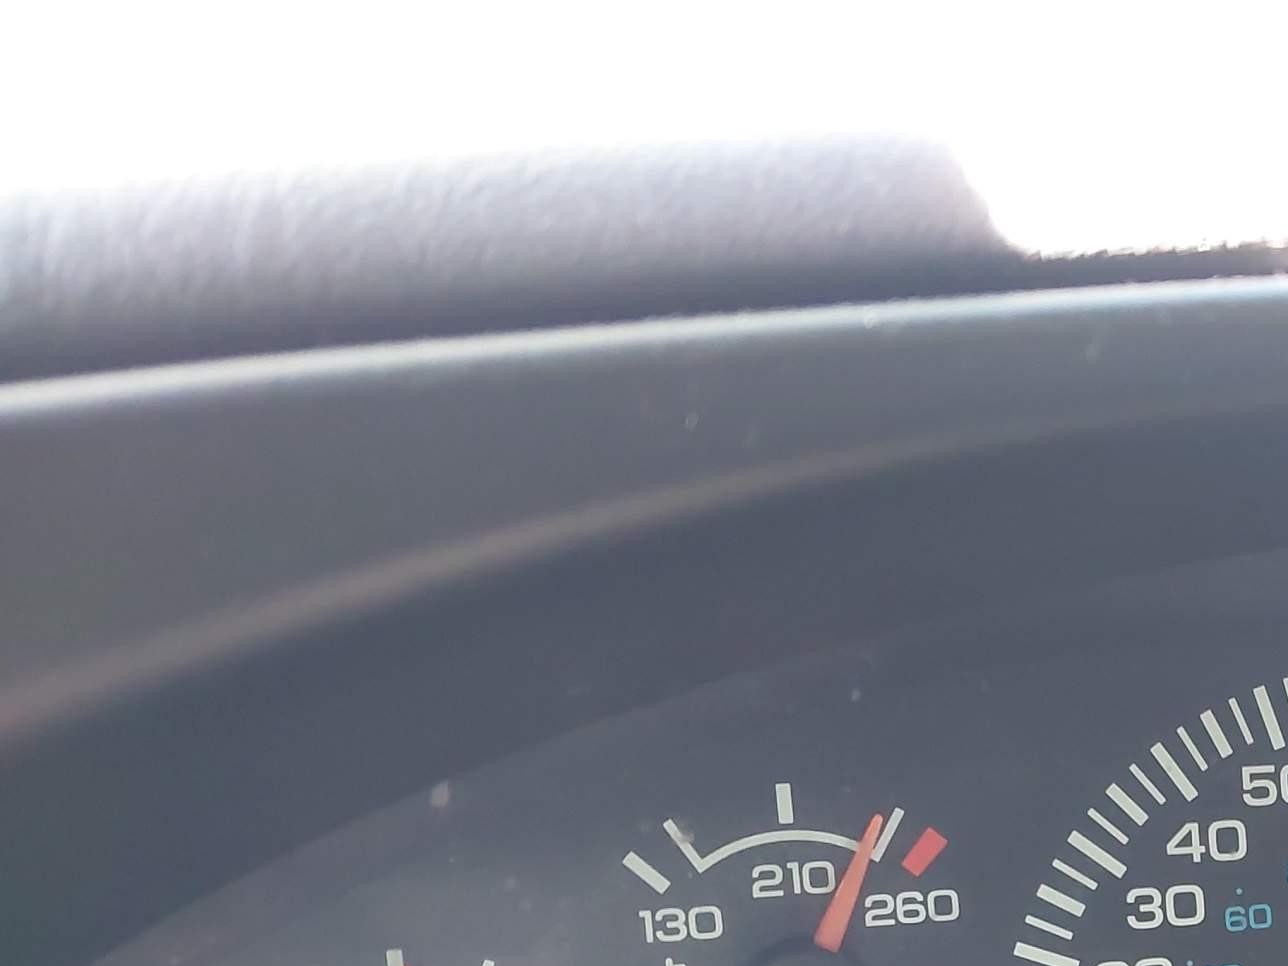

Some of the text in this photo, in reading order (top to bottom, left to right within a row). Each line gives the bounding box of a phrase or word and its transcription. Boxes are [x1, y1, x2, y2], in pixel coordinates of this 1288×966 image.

[1166, 819, 1248, 863] 40
[751, 860, 836, 898] 210
[638, 905, 725, 943] 130
[864, 889, 960, 927] 260
[1126, 884, 1206, 930] 30
[1224, 903, 1273, 932] 60
